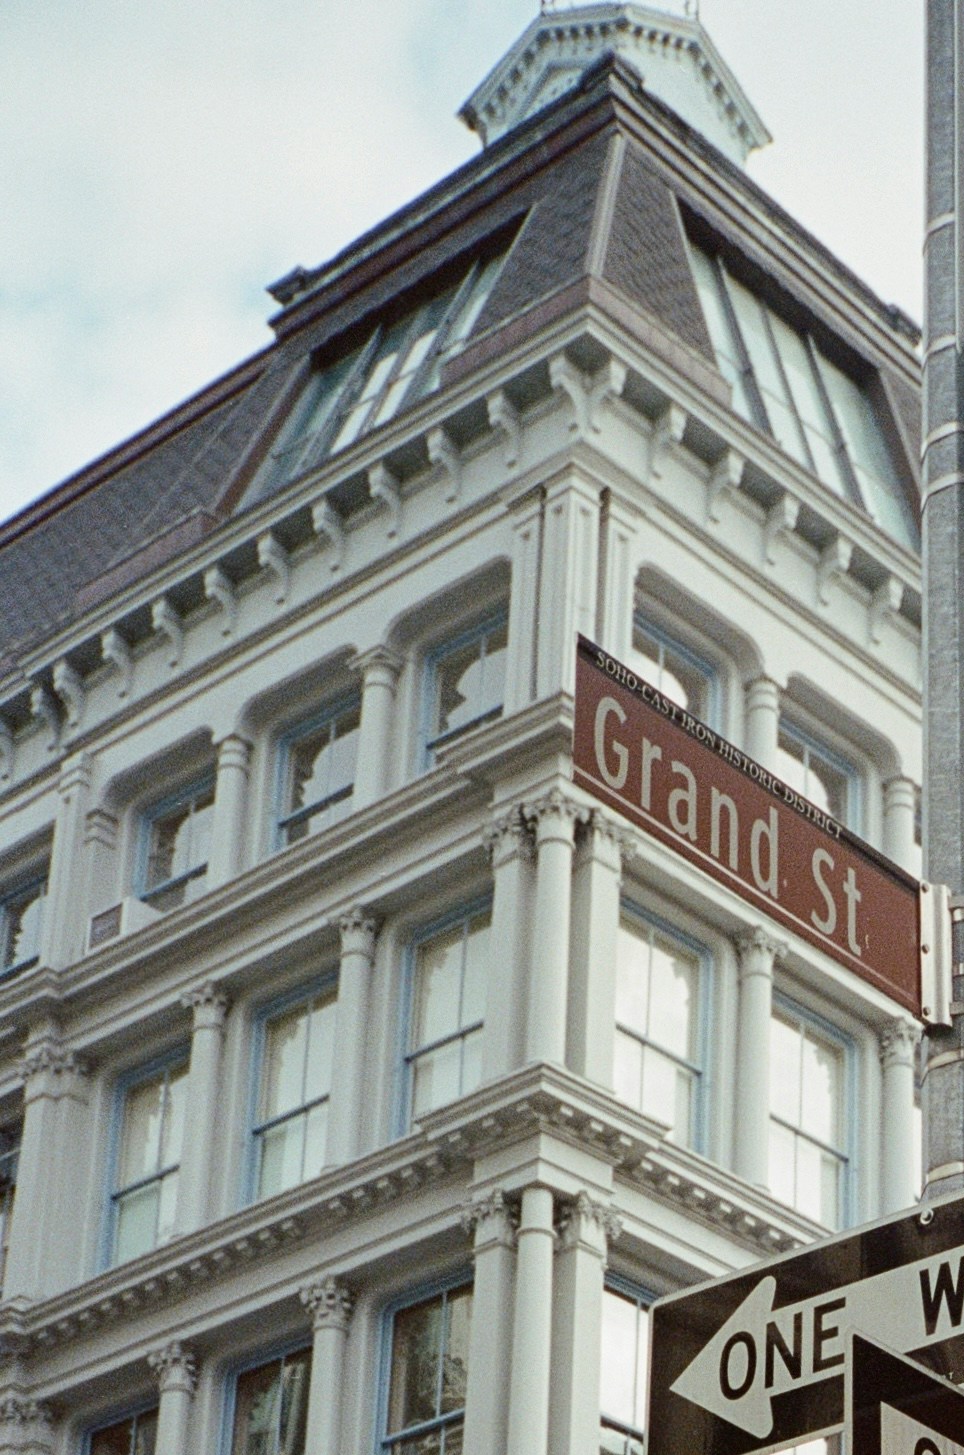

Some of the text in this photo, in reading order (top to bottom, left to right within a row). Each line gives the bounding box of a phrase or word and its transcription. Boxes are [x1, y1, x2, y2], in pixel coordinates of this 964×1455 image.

[594, 696, 862, 957] Grand St
[596, 652, 843, 839] SOHO-CAST IRON HISTORIC DISTRICT
[718, 1296, 847, 1401] ONE
